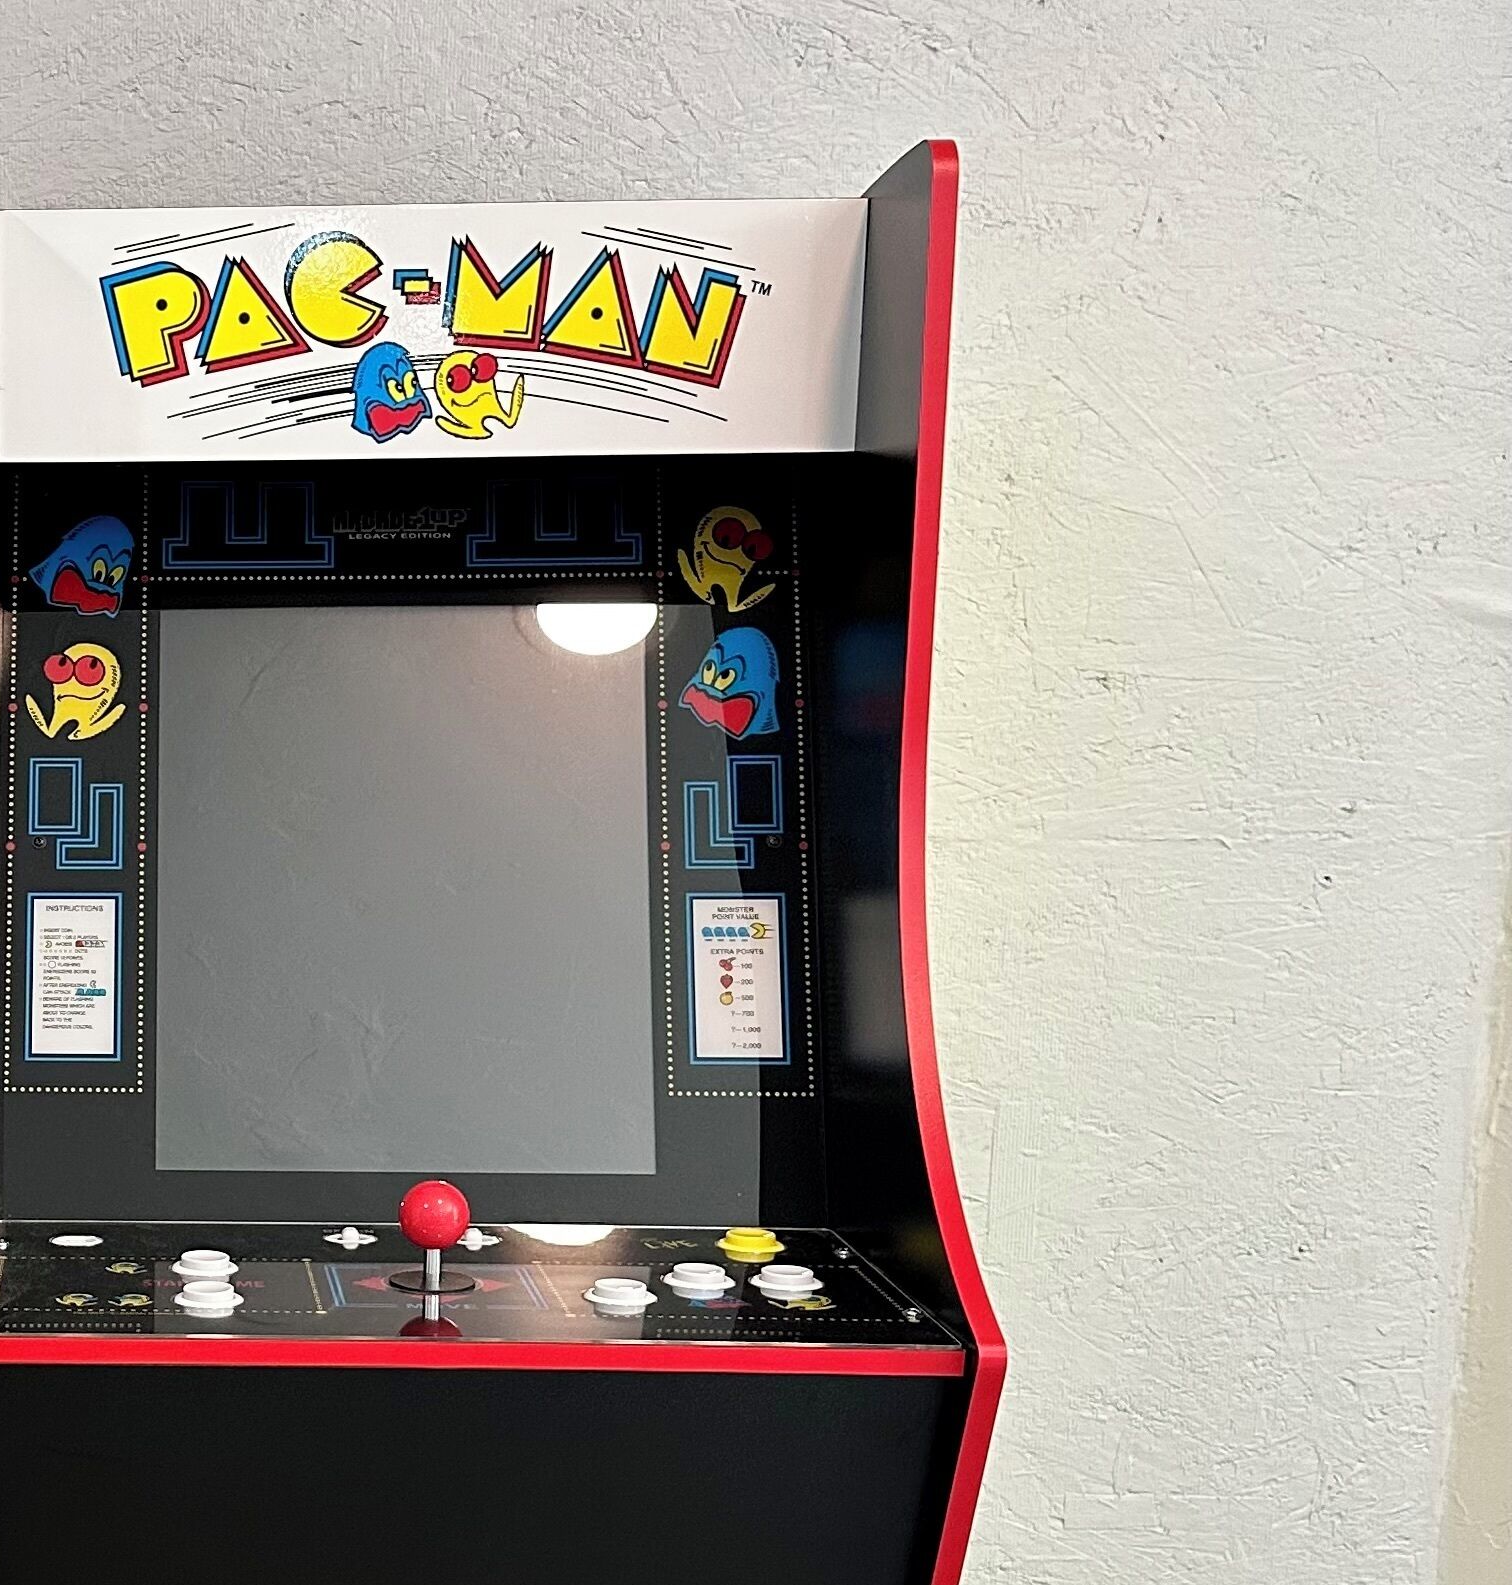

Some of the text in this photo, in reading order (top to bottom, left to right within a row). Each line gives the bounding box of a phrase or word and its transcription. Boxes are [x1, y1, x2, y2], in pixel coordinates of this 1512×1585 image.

[100, 230, 746, 388] PAC-MAN
[348, 532, 452, 541] LEGACY EDITION
[45, 904, 104, 912] INSTRUCTIONS
